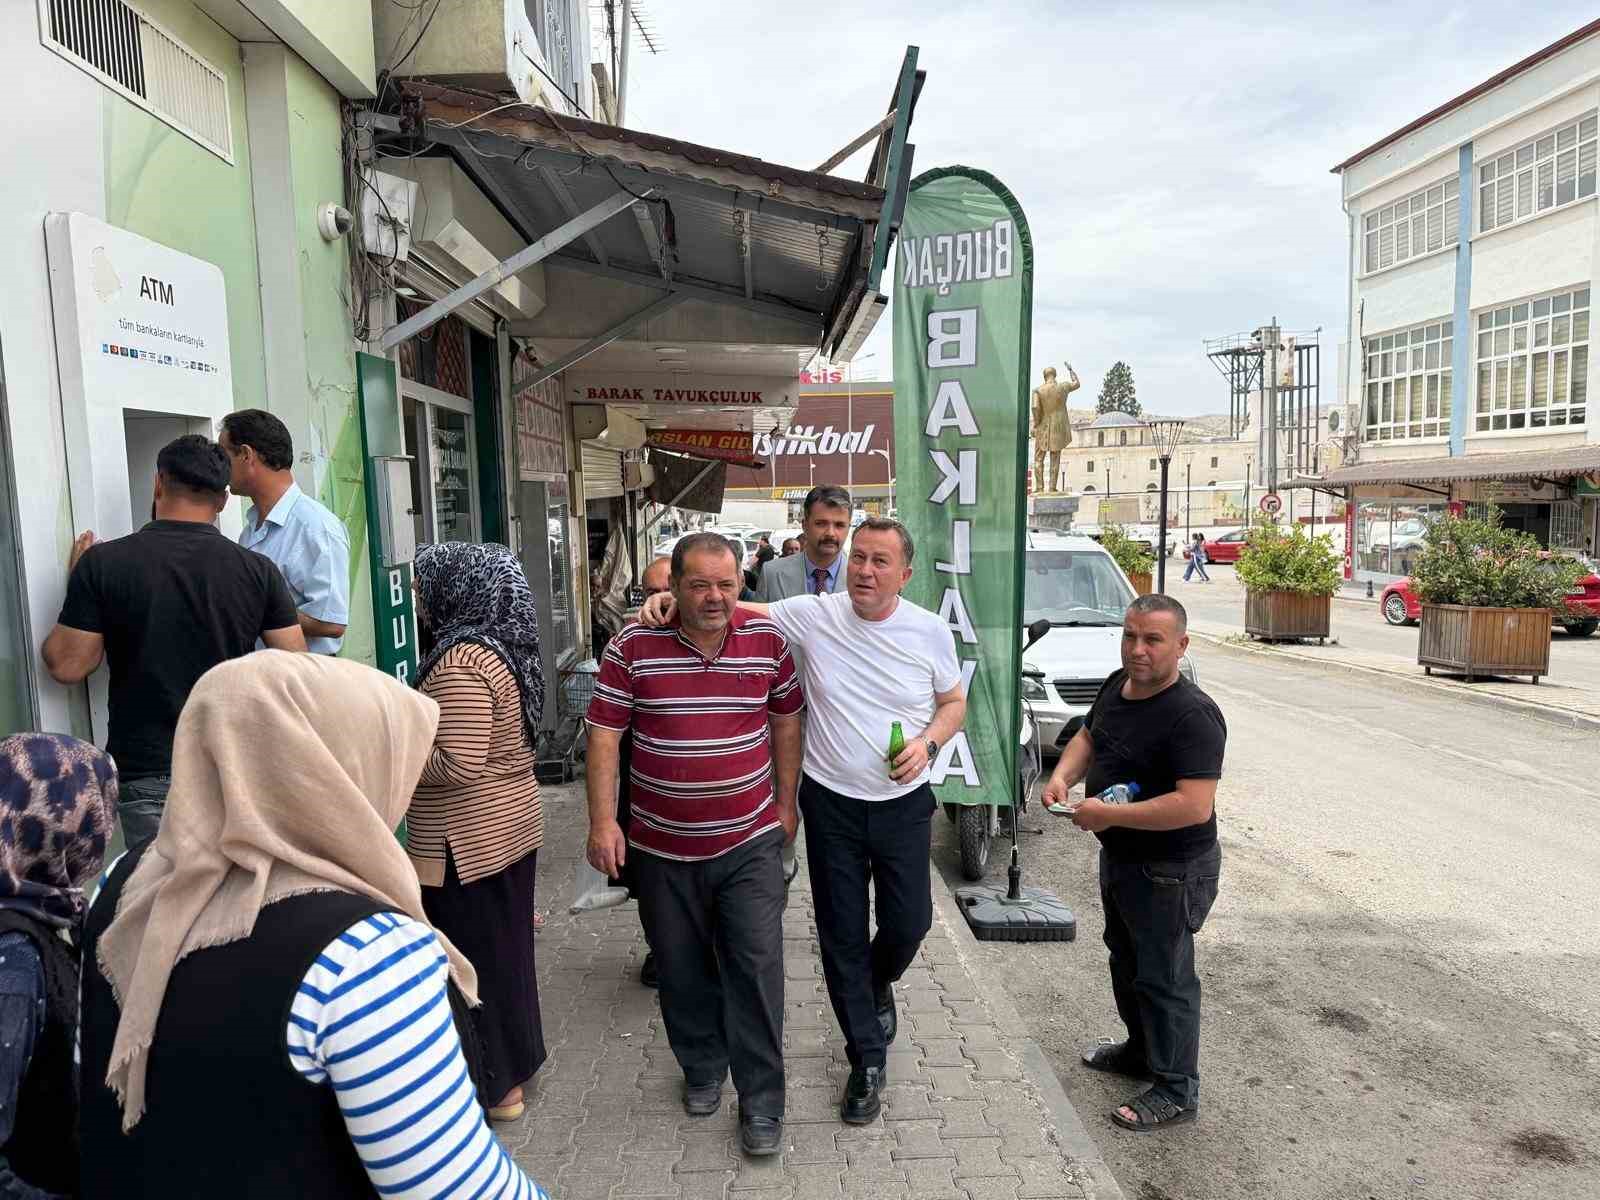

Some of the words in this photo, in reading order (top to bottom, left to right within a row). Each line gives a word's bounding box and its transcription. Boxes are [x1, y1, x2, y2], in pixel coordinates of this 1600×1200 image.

[139, 275, 175, 306] ATM
[118, 318, 135, 331] tüm
[136, 321, 172, 340] bankaların
[587, 387, 644, 401] BARAK
[653, 389, 763, 405] TAVUKÇULUK
[389, 570, 408, 686] BUR
